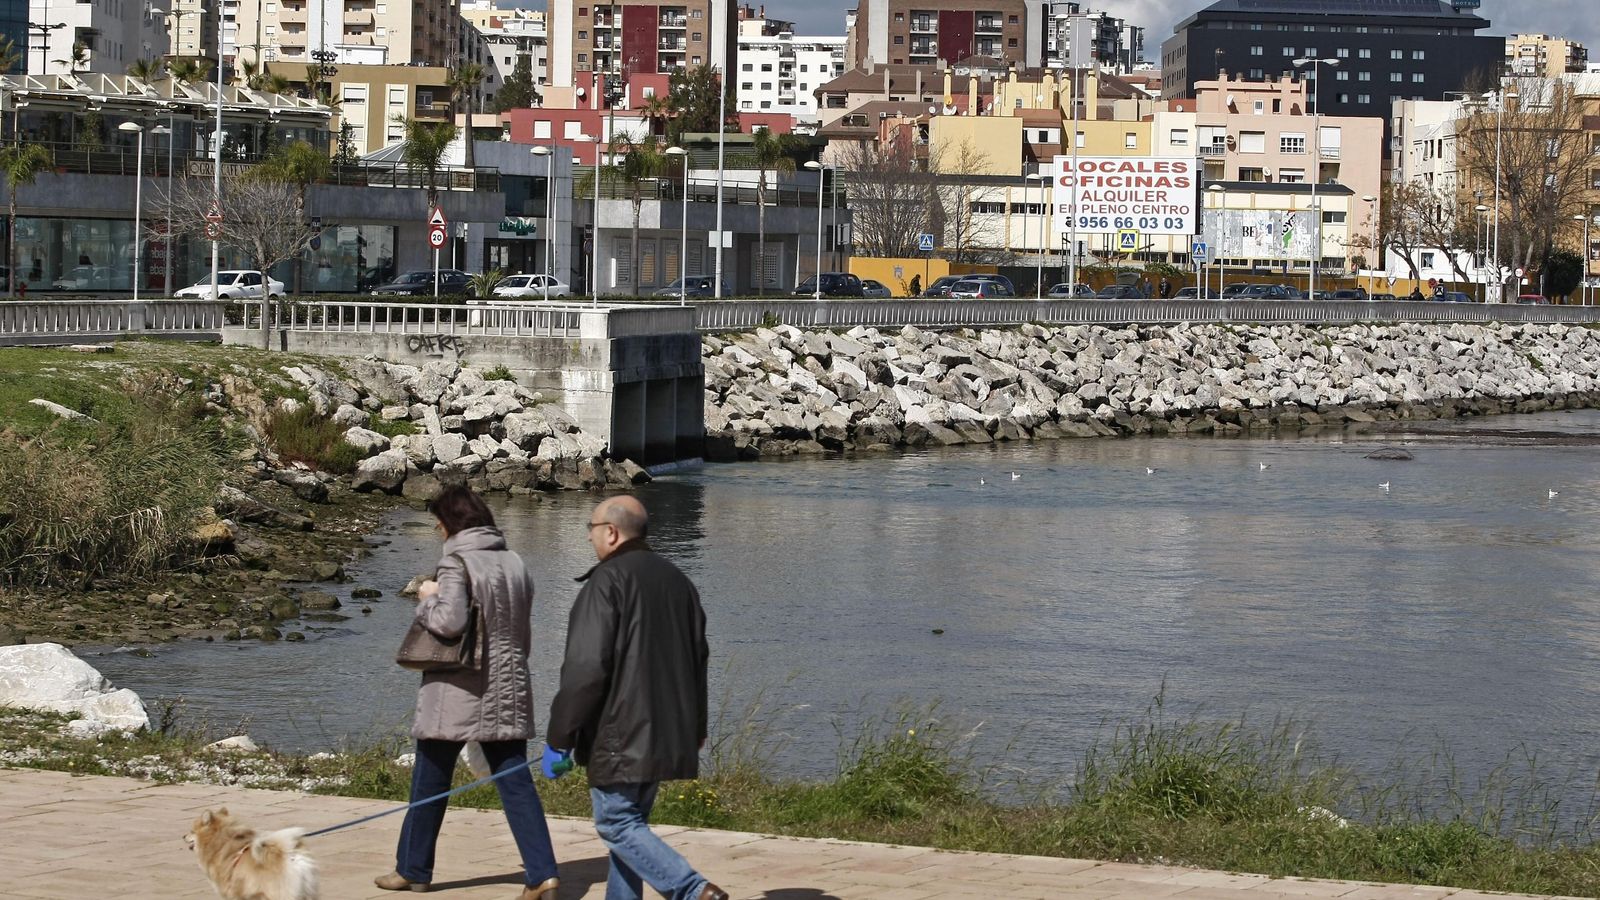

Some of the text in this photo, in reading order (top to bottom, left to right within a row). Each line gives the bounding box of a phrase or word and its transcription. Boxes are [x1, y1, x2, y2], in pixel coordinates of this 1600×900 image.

[1063, 161, 1188, 173] LOCALES
[1059, 176, 1190, 188] OFICINAS
[1081, 190, 1168, 203] ALQUILER
[1082, 204, 1128, 214] PLENO
[1132, 205, 1190, 215] CENTRO
[1079, 216, 1184, 229] 956 66 03 03
[432, 233, 442, 242] 20
